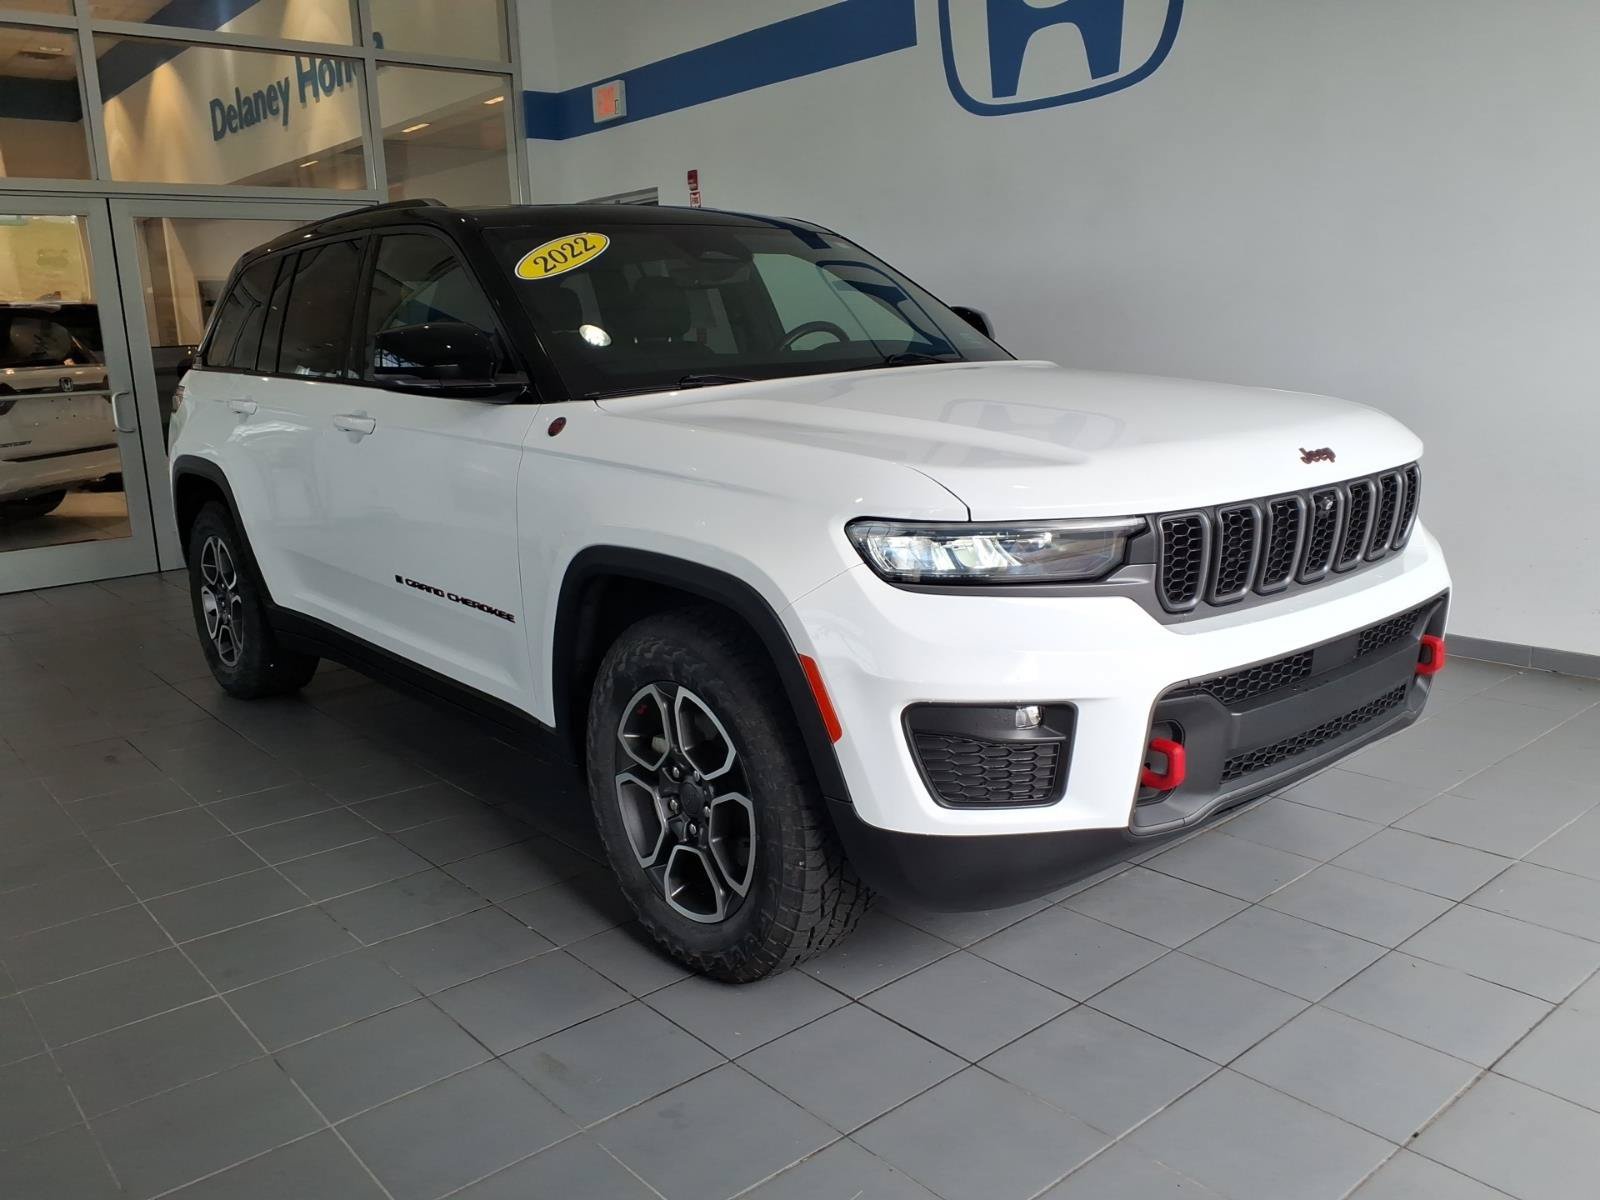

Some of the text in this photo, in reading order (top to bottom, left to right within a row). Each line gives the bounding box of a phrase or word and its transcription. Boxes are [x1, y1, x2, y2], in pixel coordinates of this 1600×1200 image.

[209, 32, 384, 141] Delaney Hon
[533, 237, 596, 273] 2022
[405, 578, 516, 624] GRAND CHEROKEE
